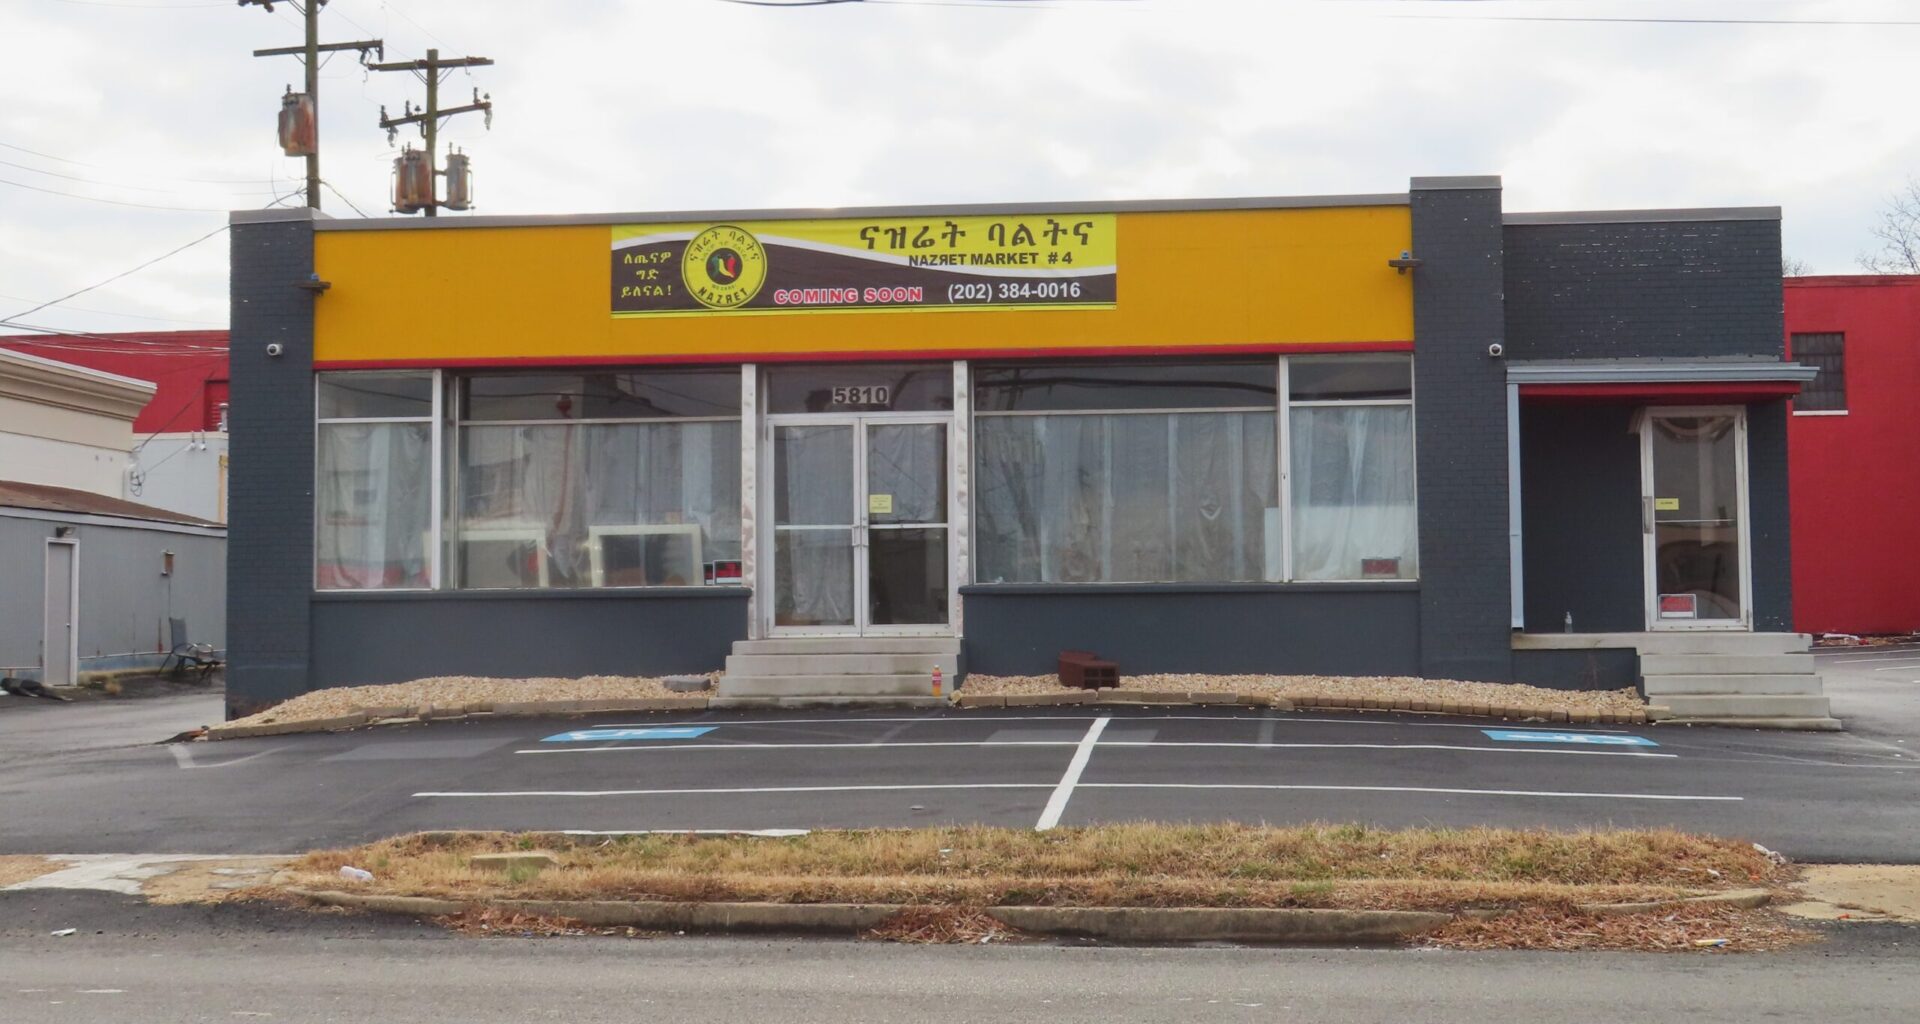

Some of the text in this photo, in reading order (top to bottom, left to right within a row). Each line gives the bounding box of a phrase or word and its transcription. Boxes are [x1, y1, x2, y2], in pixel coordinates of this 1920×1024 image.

[860, 218, 1094, 250] ናዝሬት ባልትና
[970, 252, 1039, 265] MARKET
[774, 286, 923, 304] COMING SOON
[947, 282, 1081, 303] (202) 384-0016
[834, 387, 888, 404] 5810
